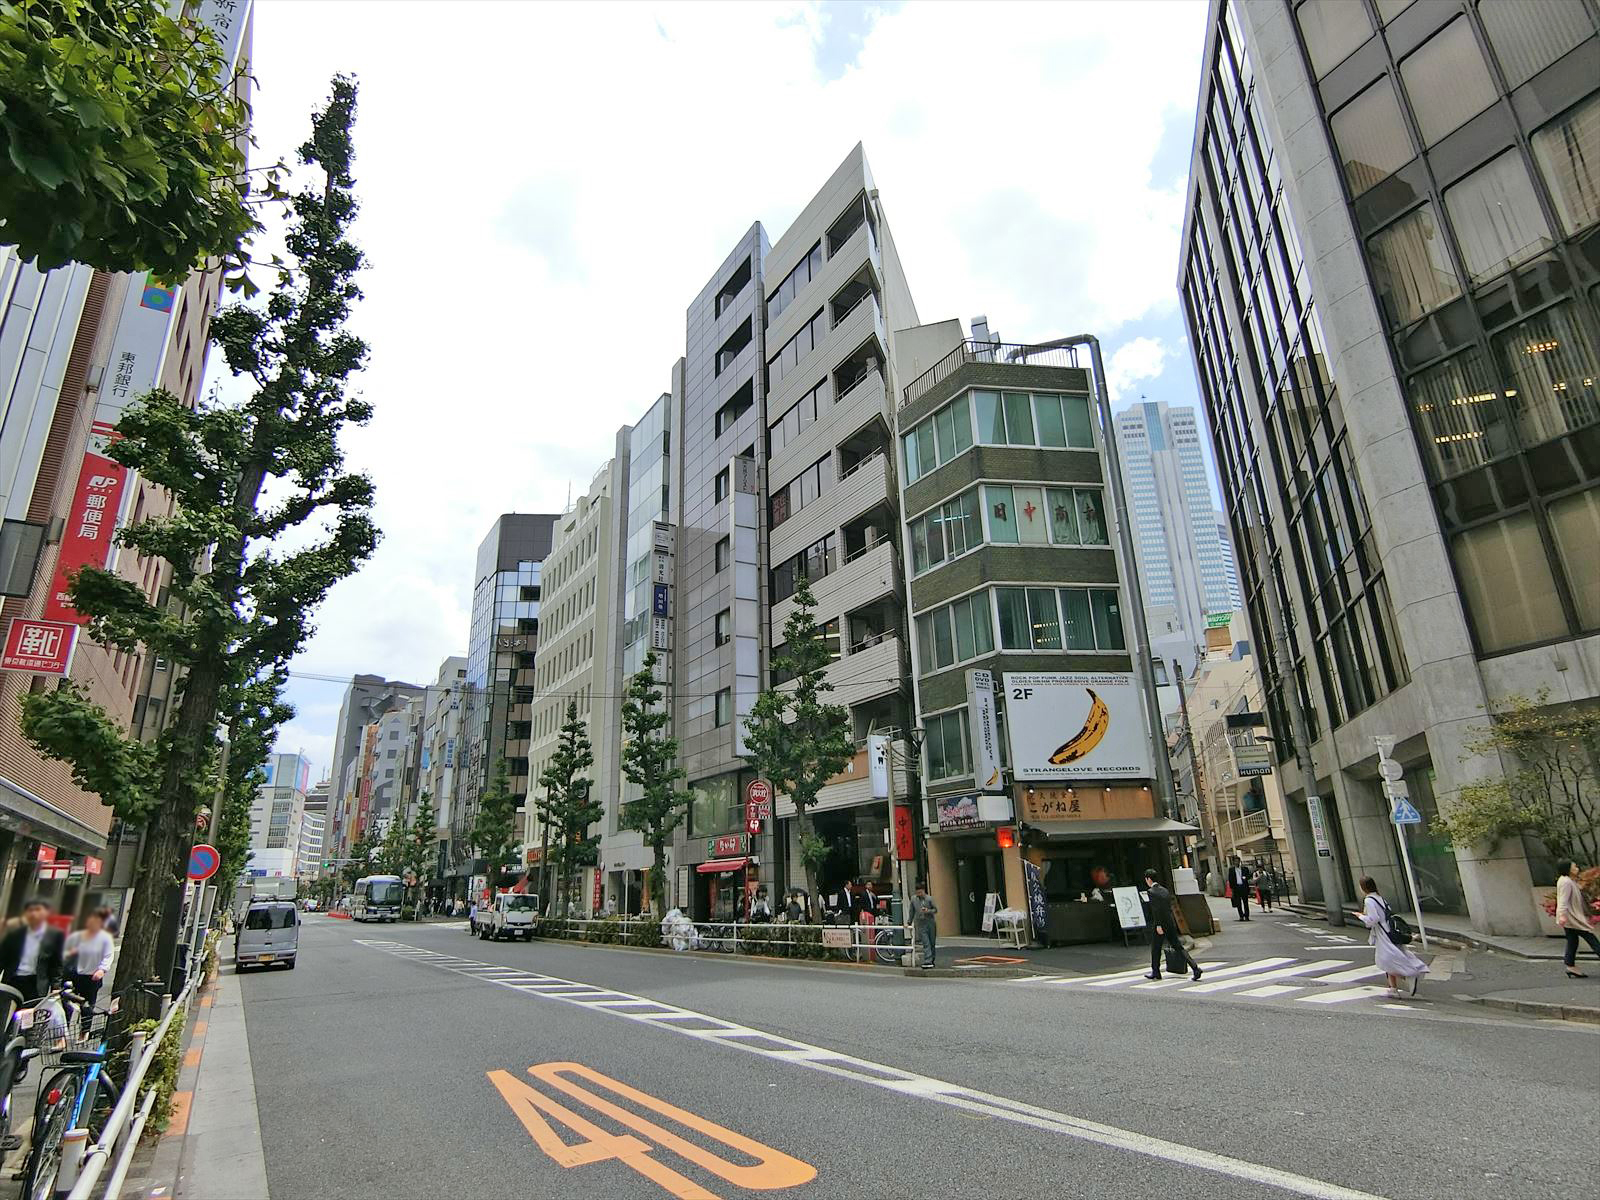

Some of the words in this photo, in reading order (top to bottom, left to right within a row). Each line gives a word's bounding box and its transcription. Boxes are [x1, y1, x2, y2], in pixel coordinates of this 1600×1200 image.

[112, 351, 137, 398] 東邦銀行
[77, 494, 108, 540] 郵便局
[21, 627, 58, 657] 靴
[1012, 688, 1033, 700] 2F
[1029, 799, 1081, 813] こがね屋
[486, 1061, 818, 1200] 40
